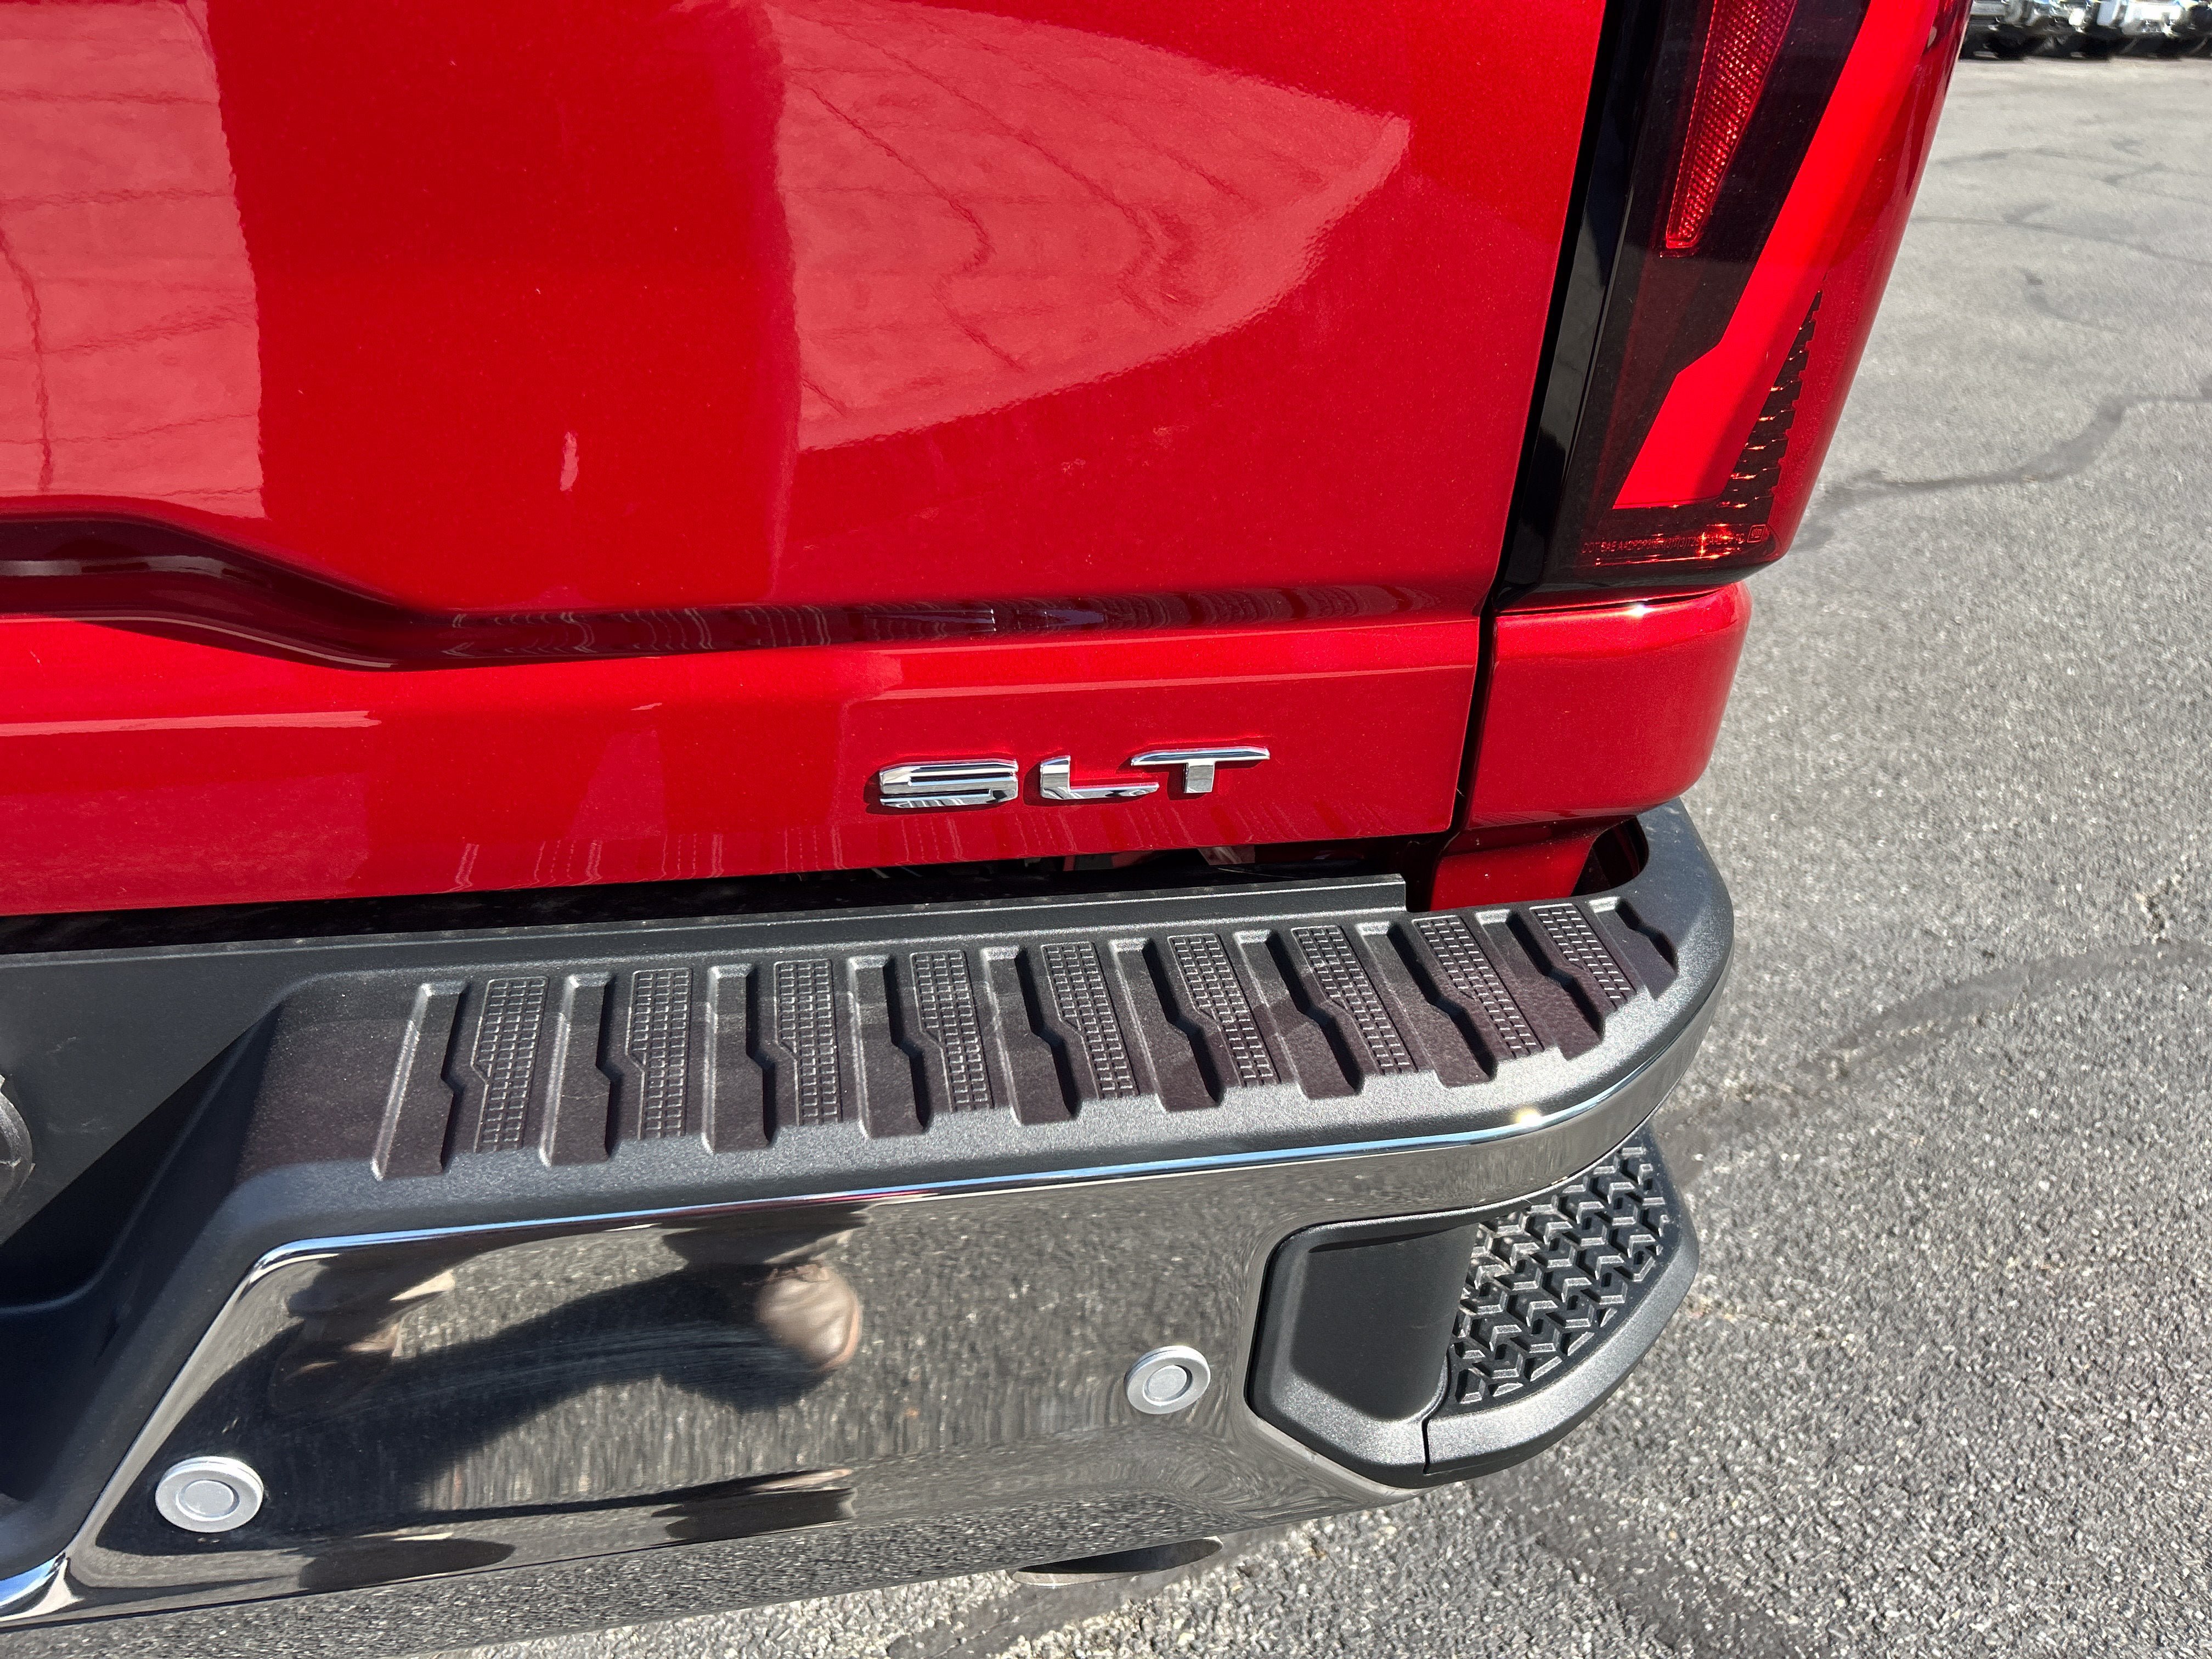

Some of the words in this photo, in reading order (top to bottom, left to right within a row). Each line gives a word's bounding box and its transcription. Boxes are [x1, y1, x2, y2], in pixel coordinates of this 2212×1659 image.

[1582, 541, 1600, 553] DOT
[1601, 541, 1617, 552] SAE
[879, 746, 1271, 809] SLT
